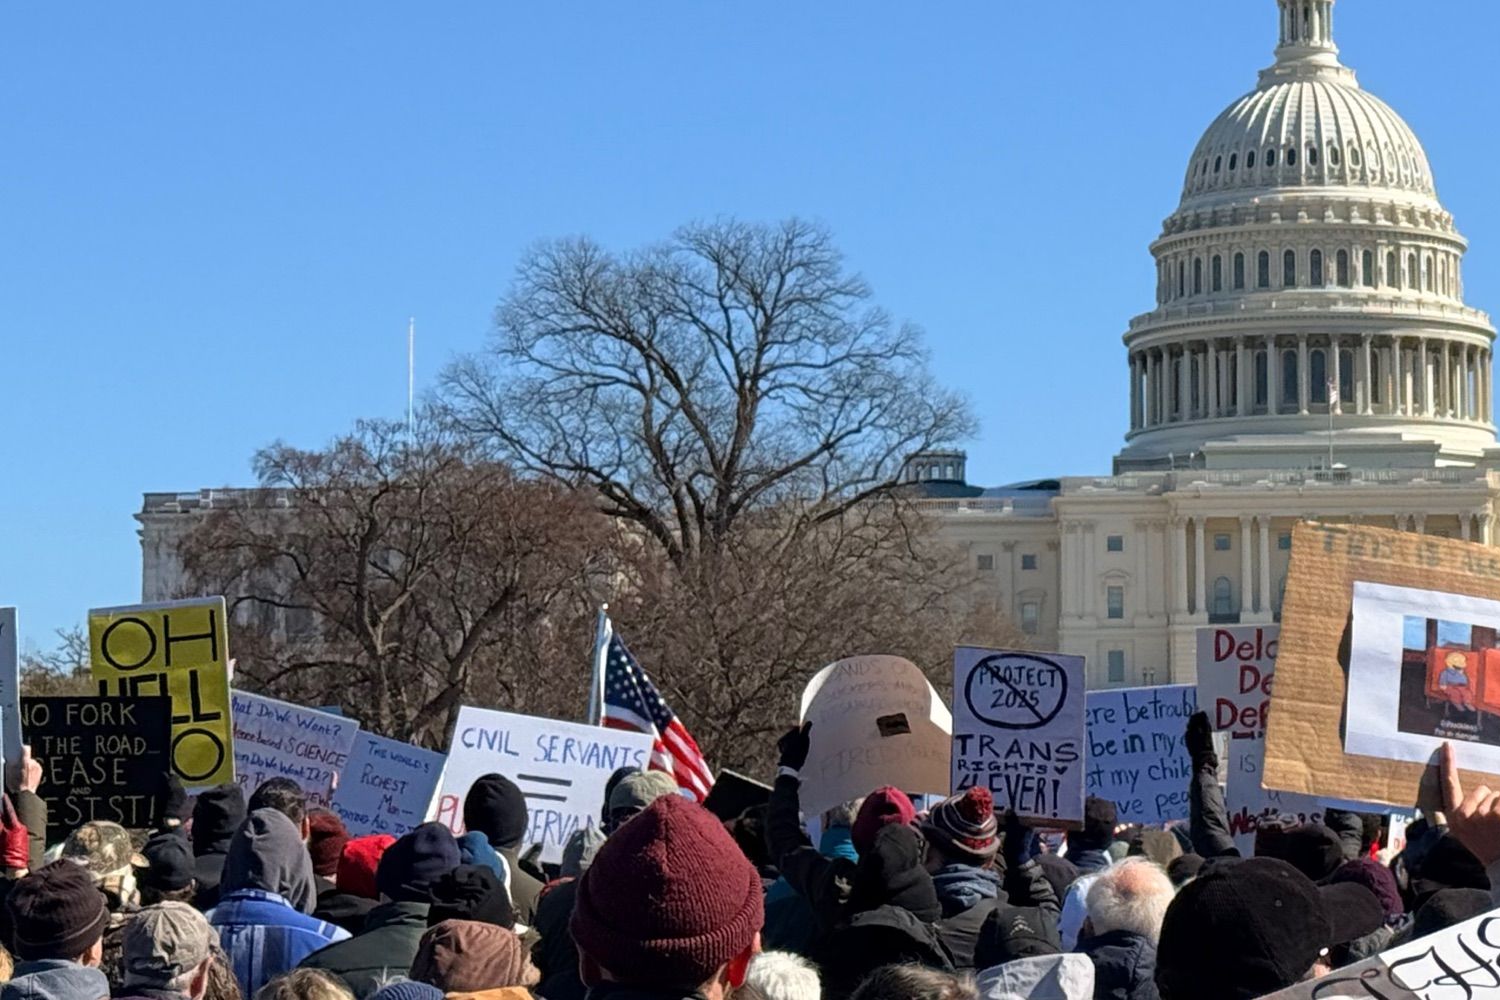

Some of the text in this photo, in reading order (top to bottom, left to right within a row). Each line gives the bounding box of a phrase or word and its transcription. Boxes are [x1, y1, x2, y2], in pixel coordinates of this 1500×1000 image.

[101, 609, 218, 671] OH
[978, 663, 1057, 689] PROJECT
[990, 689, 1040, 710] 2025
[65, 703, 137, 727] FORK
[42, 736, 81, 755] THE
[284, 737, 348, 769] SCIENCE
[461, 727, 647, 770] CIVIL SERVANTS
[955, 733, 1080, 763] TRANS
[1088, 730, 1118, 758] be
[1122, 728, 1145, 754] in
[957, 759, 1048, 775] RIGHTS
[70, 786, 92, 795] AND
[45, 796, 156, 826] ESIST!
